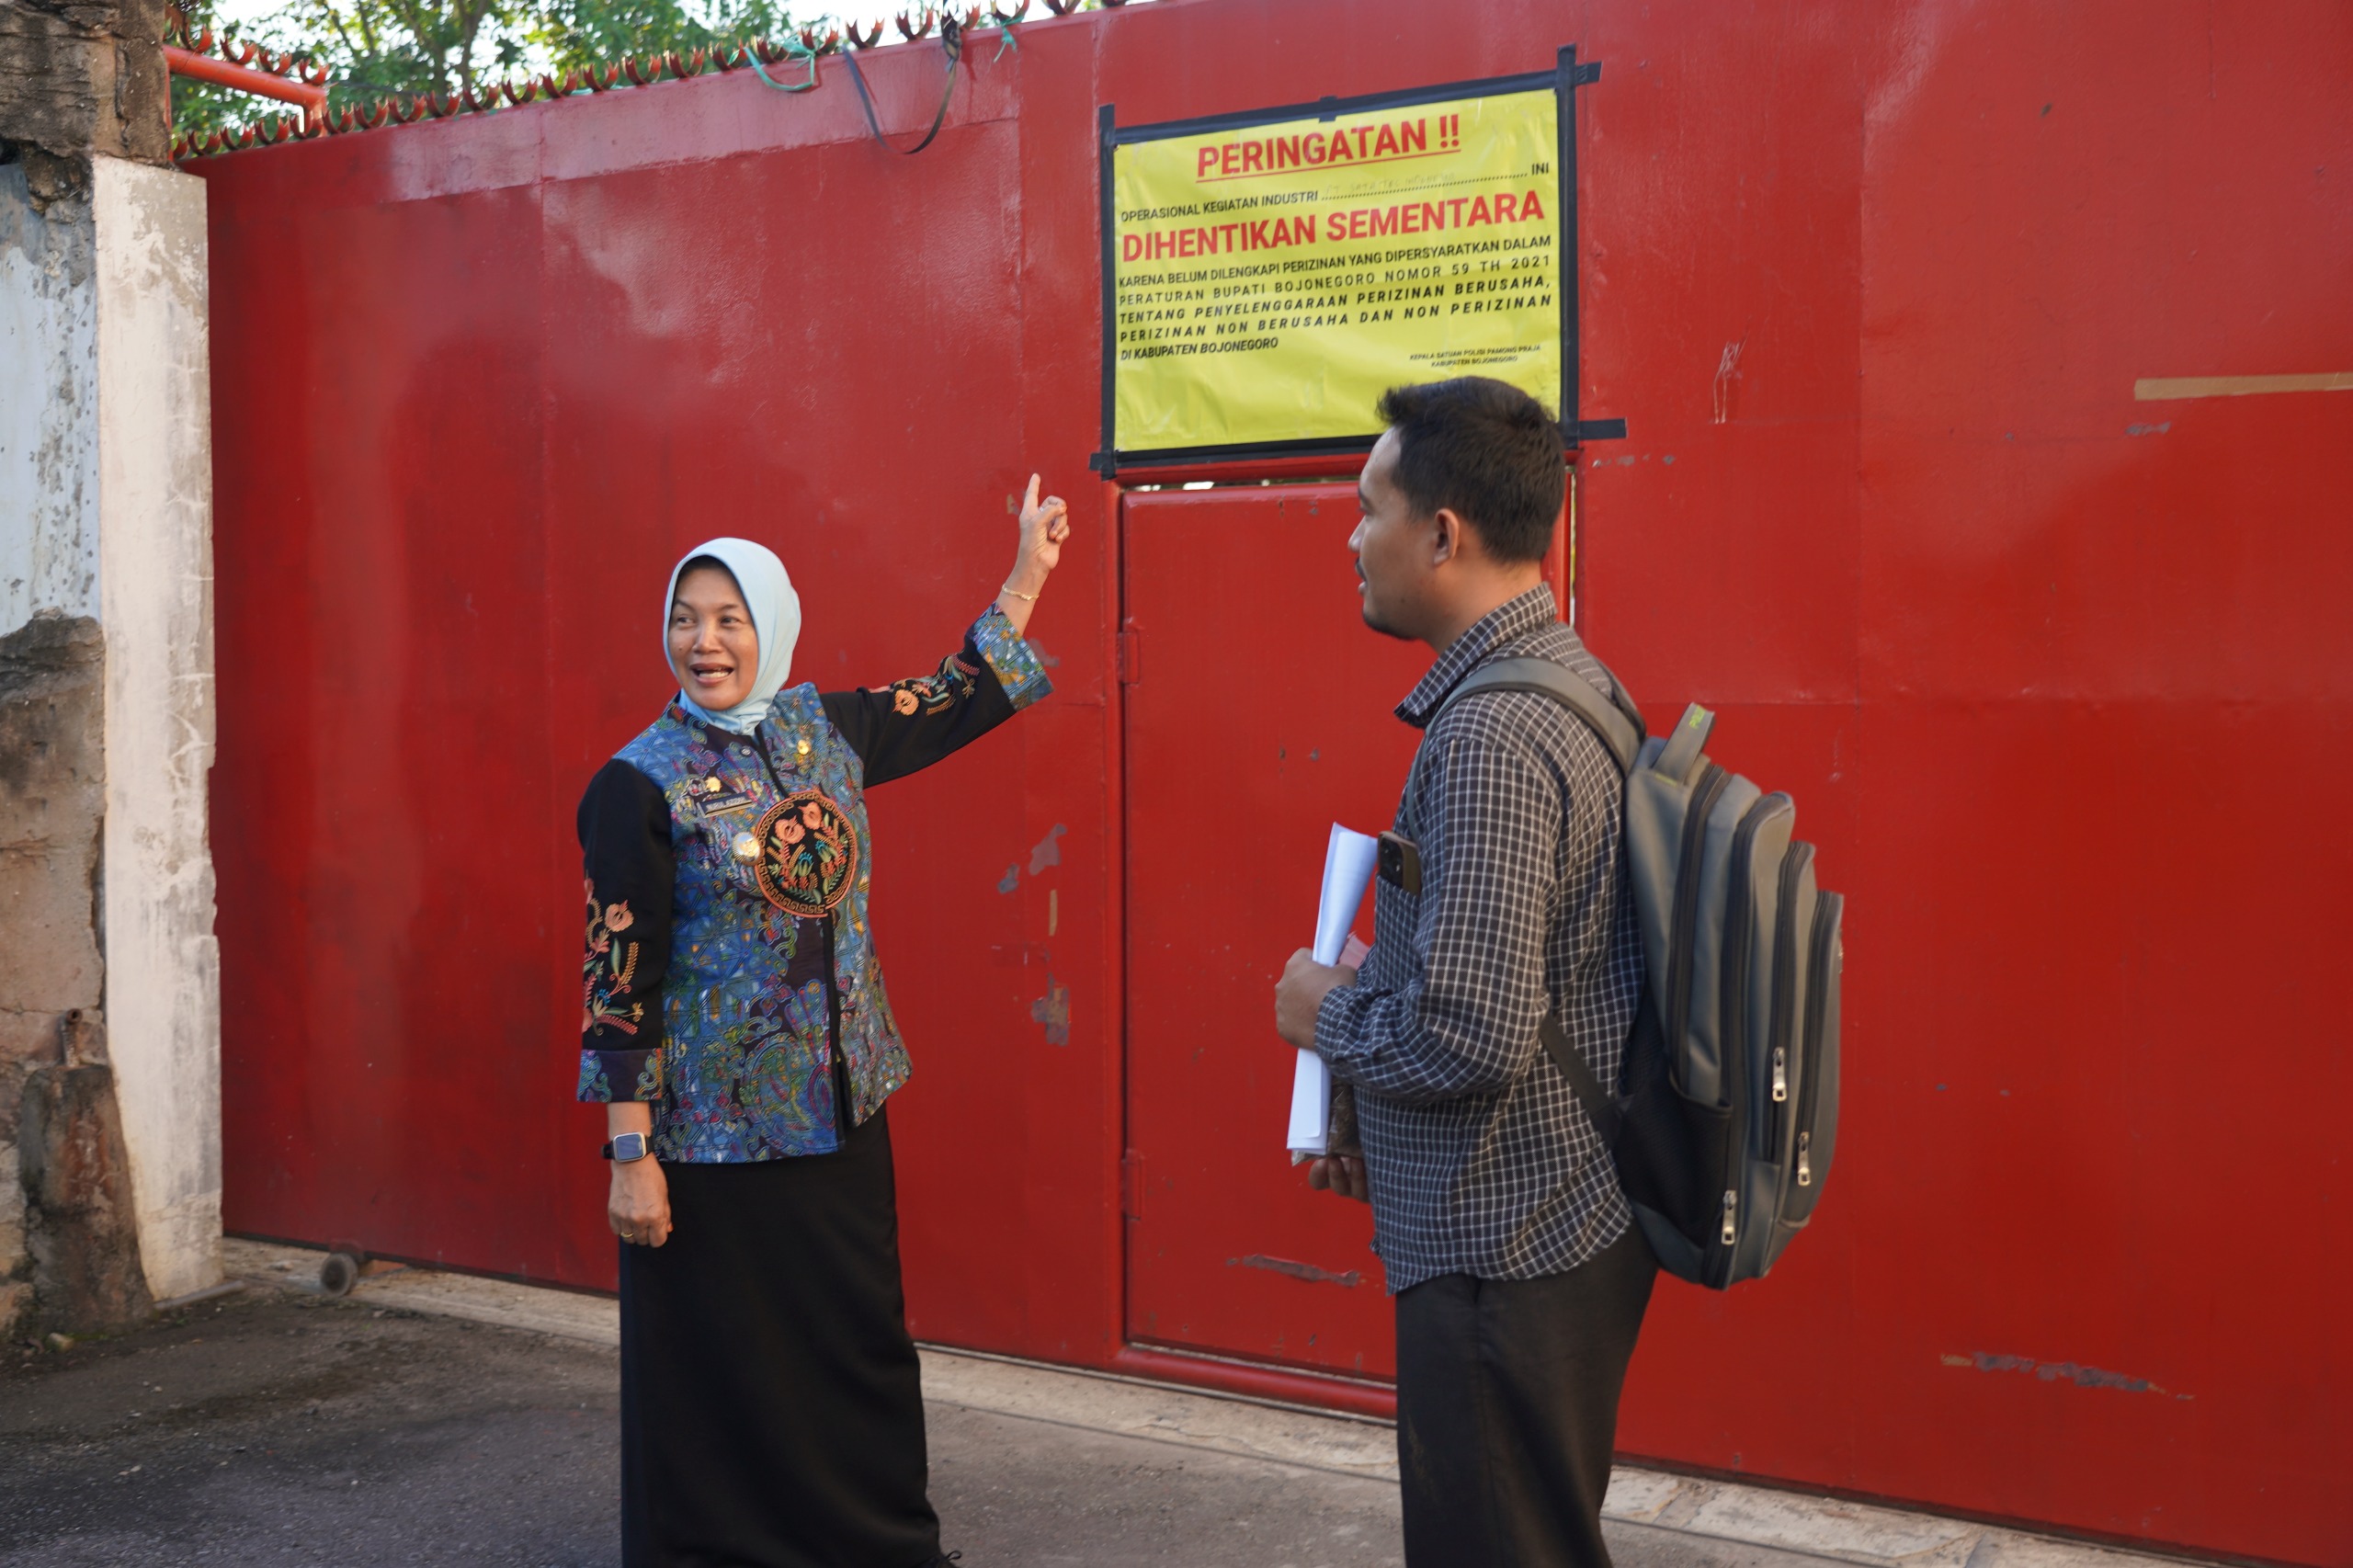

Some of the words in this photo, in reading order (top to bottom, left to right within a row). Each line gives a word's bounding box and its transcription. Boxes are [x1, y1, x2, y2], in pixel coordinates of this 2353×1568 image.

[1197, 119, 1427, 177] PERINGATAN
[1439, 114, 1460, 149] !!
[1531, 162, 1550, 176] INI
[1120, 204, 1199, 222] OPERASIONAL
[1203, 197, 1258, 214] KEGIATAN
[1262, 190, 1318, 207] INDUSTRI
[1122, 214, 1316, 263] DIHENTIKAN
[1326, 190, 1544, 242] SEMENTARA
[1119, 274, 1165, 289] KARENA
[1168, 270, 1207, 284] BELUM
[1211, 263, 1279, 279] DILENGKAPI
[1283, 256, 1346, 273] PERIZINAN
[1348, 252, 1381, 267] YANG
[1385, 240, 1499, 263] DIPERSYARATKAN
[1504, 234, 1551, 252] DALAM
[1119, 289, 1204, 306] PERATURAN
[1213, 284, 1266, 300] BUPATI
[1275, 272, 1375, 293] BOJONEGORO
[1385, 266, 1441, 283] NOMOR
[1451, 263, 1470, 276] 59
[1481, 260, 1500, 273] TH
[1511, 255, 1550, 269] 2021
[1120, 308, 1185, 324] TENTANG
[1195, 294, 1347, 318] PENYELENGGARAAN
[1357, 285, 1444, 304] PERIZINAN
[1455, 275, 1551, 295] BERUSAHA,
[1120, 325, 1206, 343] PERIZINAN
[1216, 321, 1248, 335] NON
[1257, 313, 1348, 331] BERUSAHA
[1359, 309, 1393, 324] DAN
[1404, 305, 1439, 320] NON
[1450, 294, 1552, 315] PERIZINAN
[1120, 349, 1131, 360] DI
[1134, 343, 1197, 359] KABUPATEN
[1200, 336, 1279, 354] BOJONEGORO
[1410, 353, 1434, 361] KEPALA
[1436, 349, 1462, 359] SATUAN
[1518, 344, 1541, 353] PRAJA
